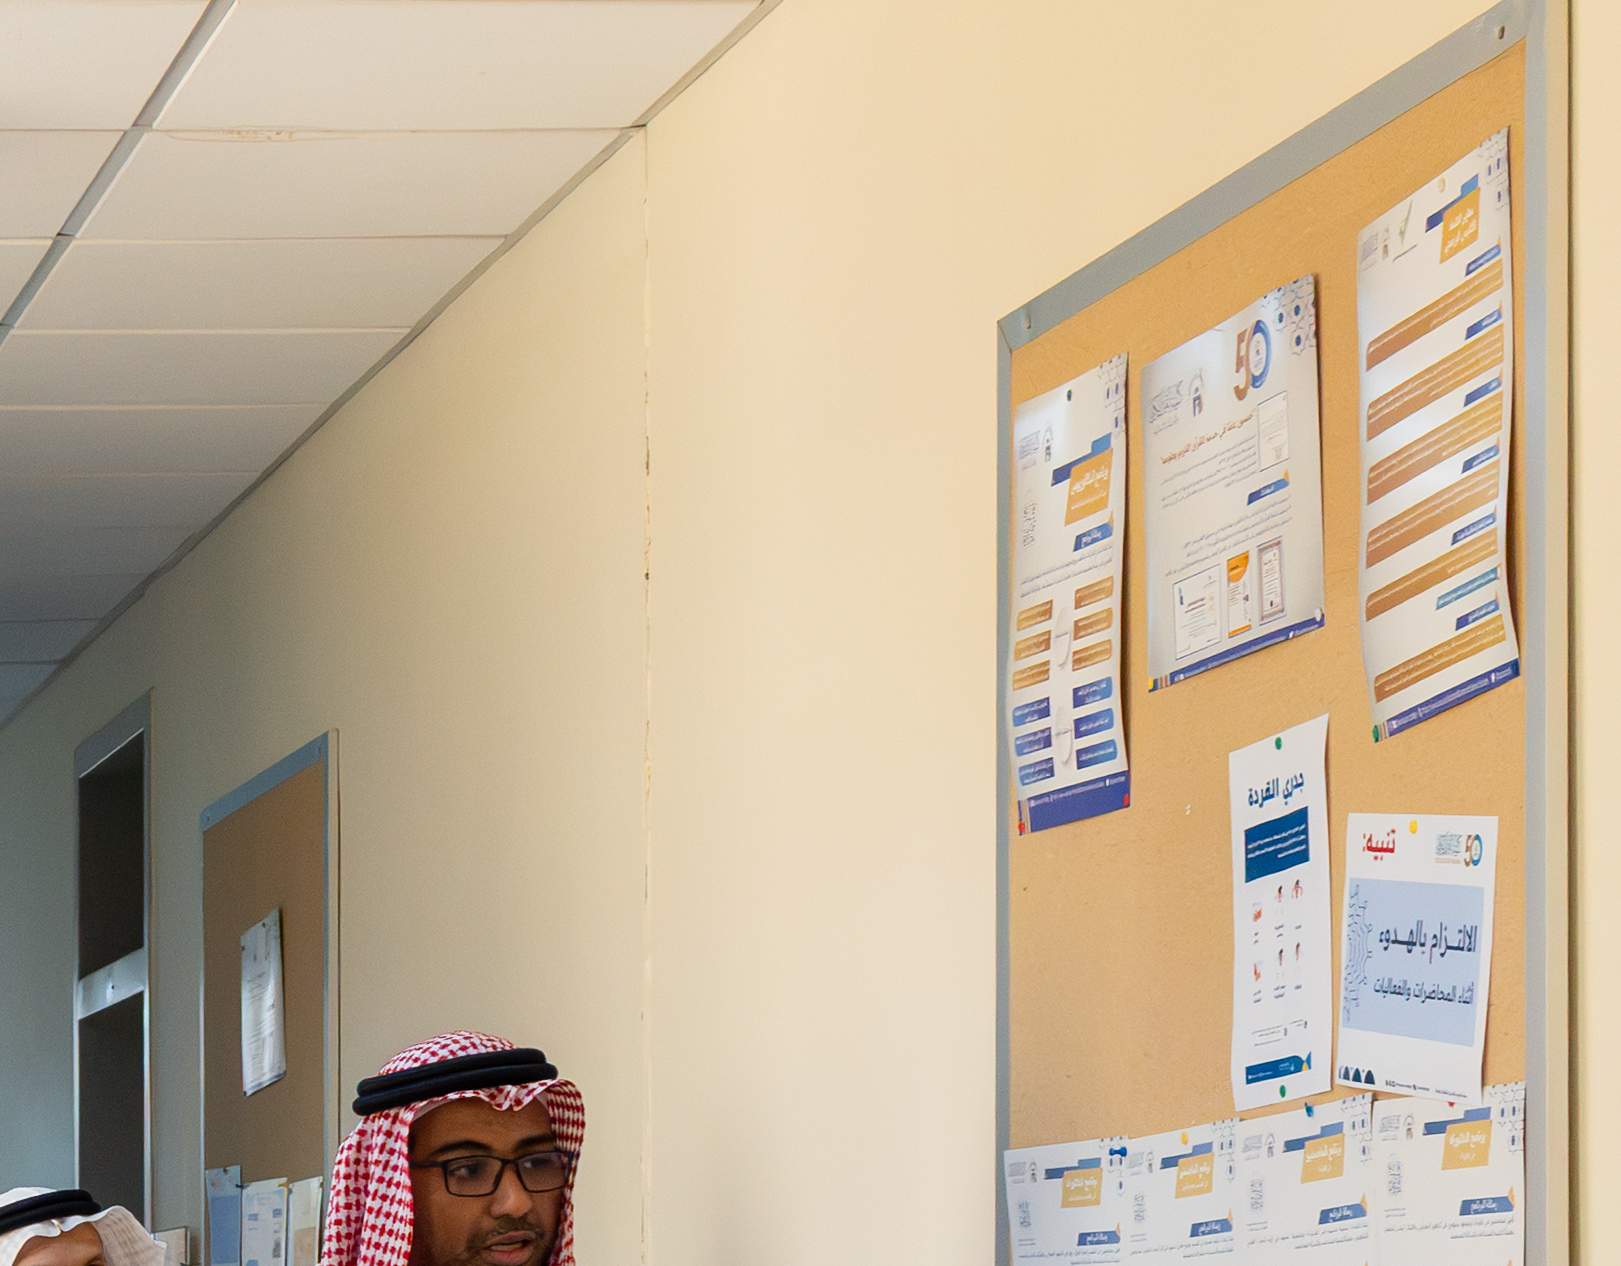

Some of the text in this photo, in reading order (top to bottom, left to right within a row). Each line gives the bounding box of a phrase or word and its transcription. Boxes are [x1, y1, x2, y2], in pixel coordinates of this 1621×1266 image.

[1233, 319, 1271, 401] 50
[1248, 772, 1305, 808] جدري القردة
[1362, 829, 1396, 861] تنبيه:
[1412, 981, 1457, 1004] المحاضرات
